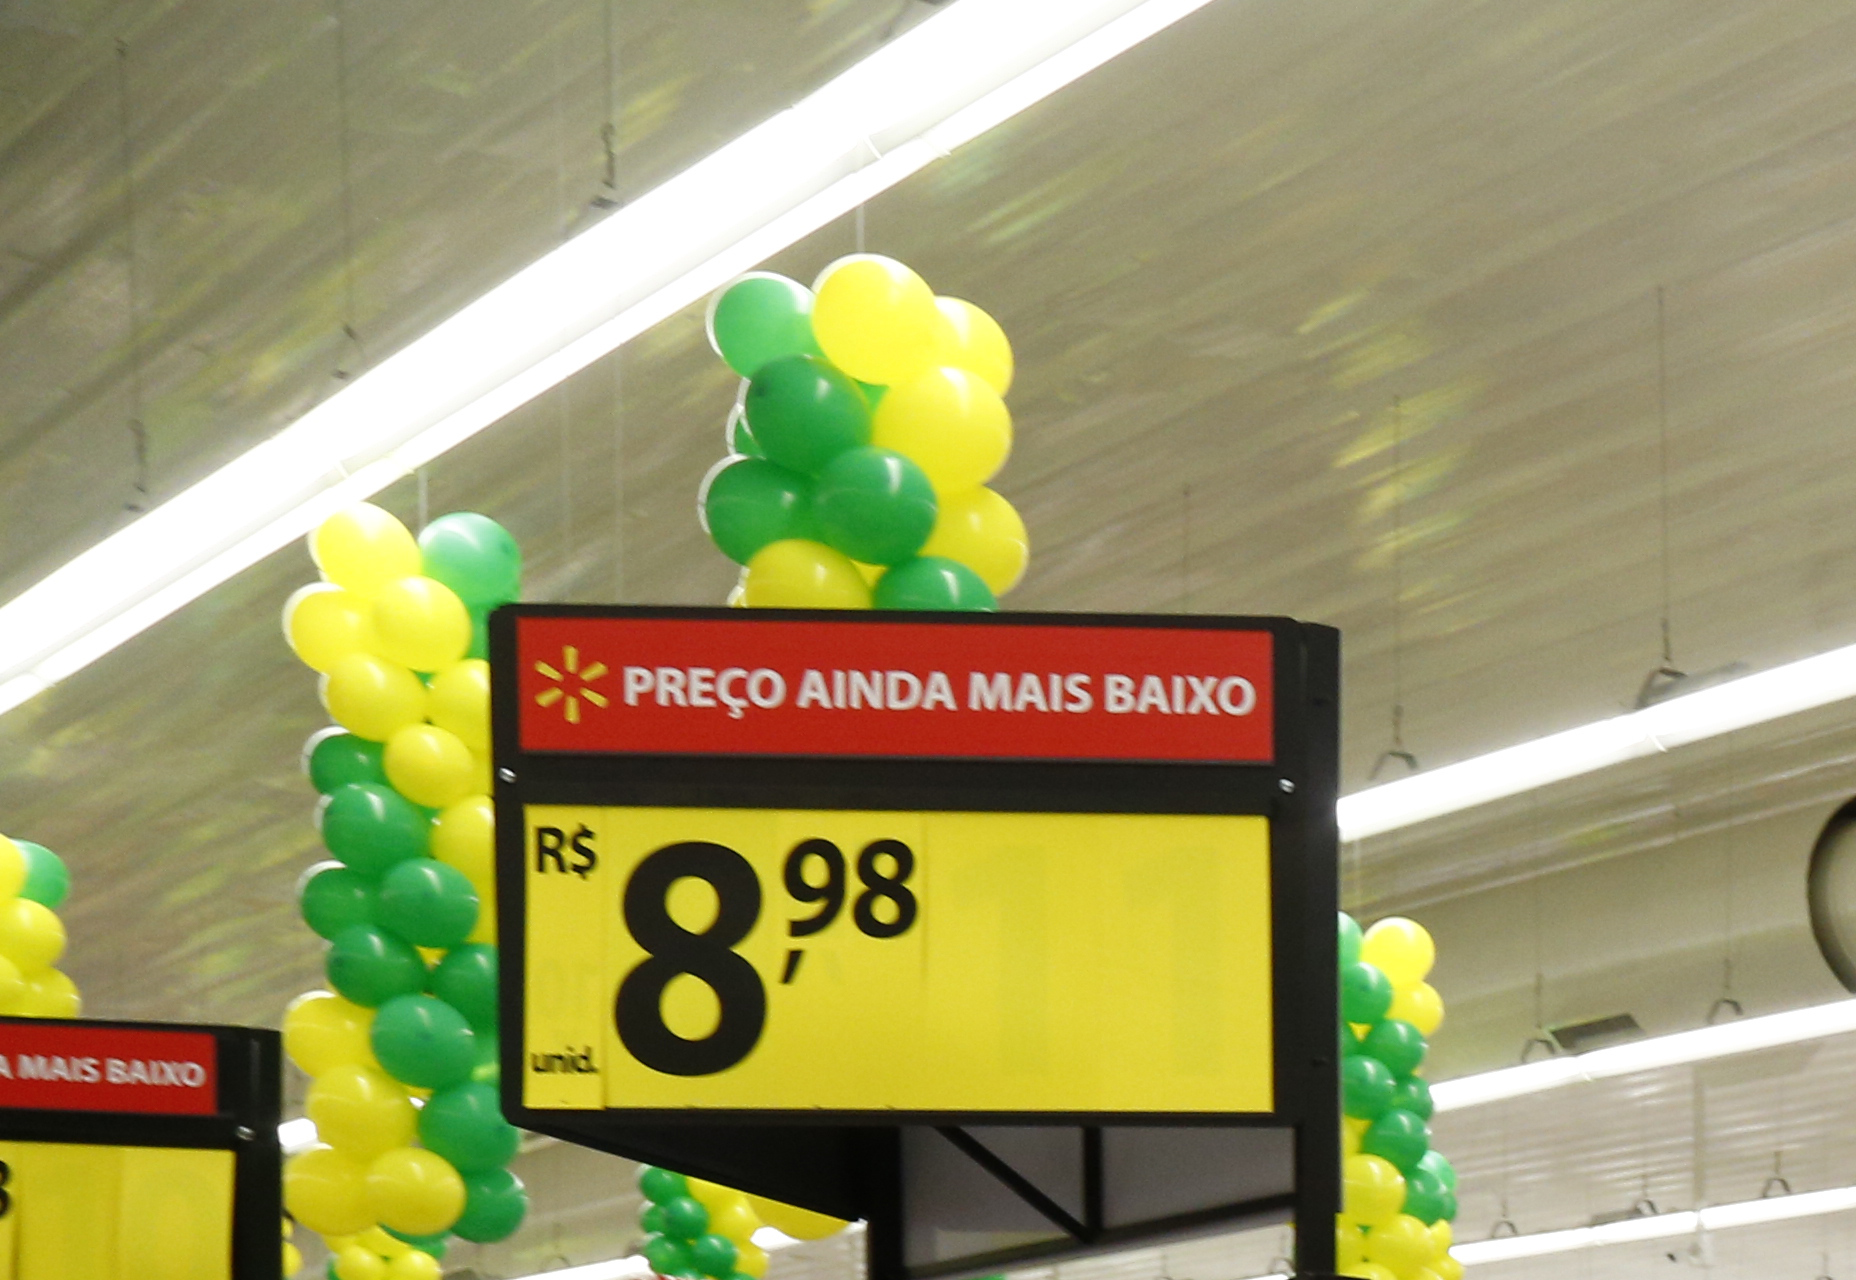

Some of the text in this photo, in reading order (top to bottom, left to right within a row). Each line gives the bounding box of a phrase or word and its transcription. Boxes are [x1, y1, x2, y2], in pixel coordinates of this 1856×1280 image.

[623, 665, 1256, 721] PREÇO AINDA MAIS BAIXO
[535, 825, 598, 878] R$
[18, 1054, 101, 1083] MAIS
[105, 1057, 206, 1088] BAIXO
[531, 1046, 600, 1077] unid.
